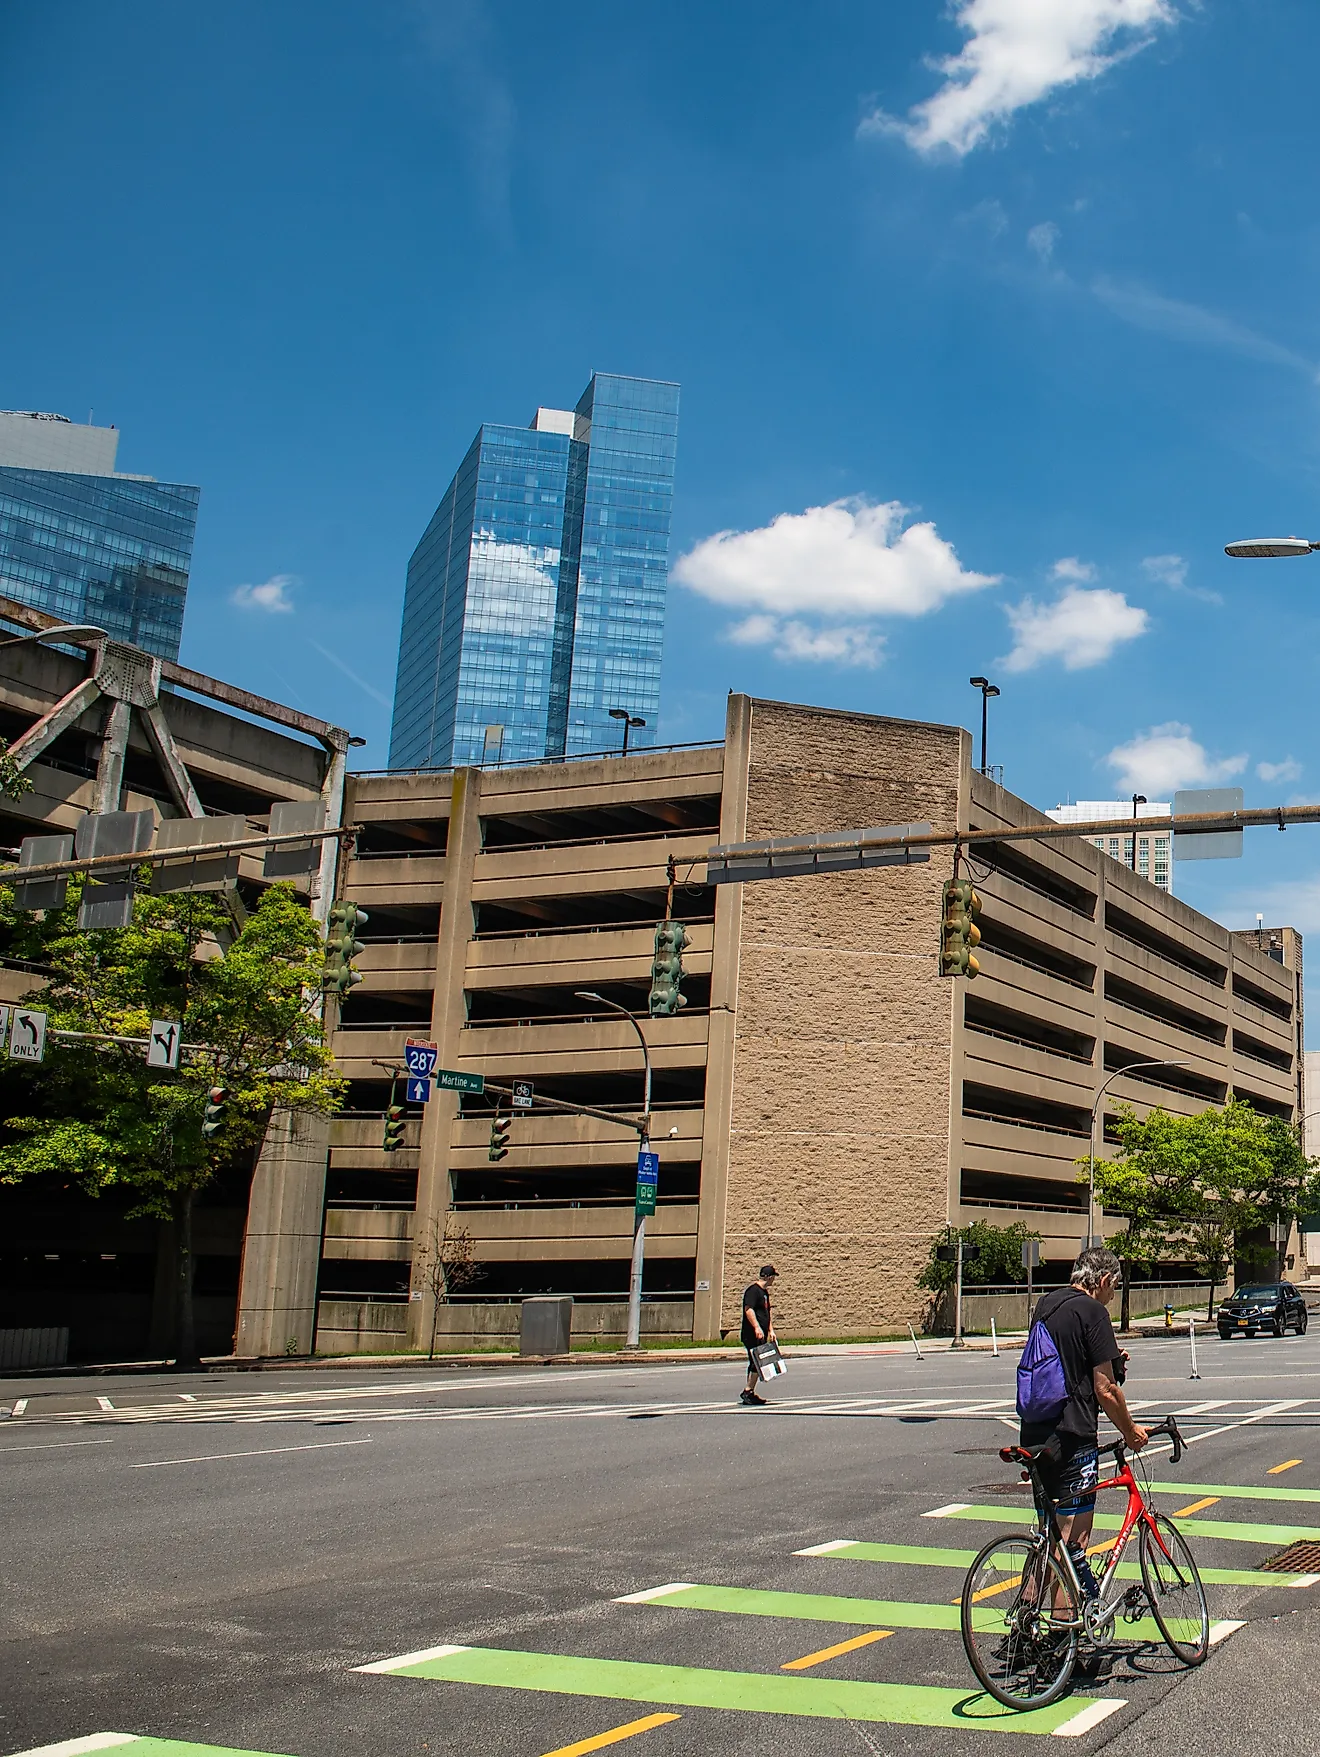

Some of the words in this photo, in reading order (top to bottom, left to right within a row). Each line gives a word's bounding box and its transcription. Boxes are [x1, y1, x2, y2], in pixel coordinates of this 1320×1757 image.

[14, 1044, 39, 1057] ONLY
[409, 1051, 436, 1071] 287
[441, 1074, 468, 1087] Martine
